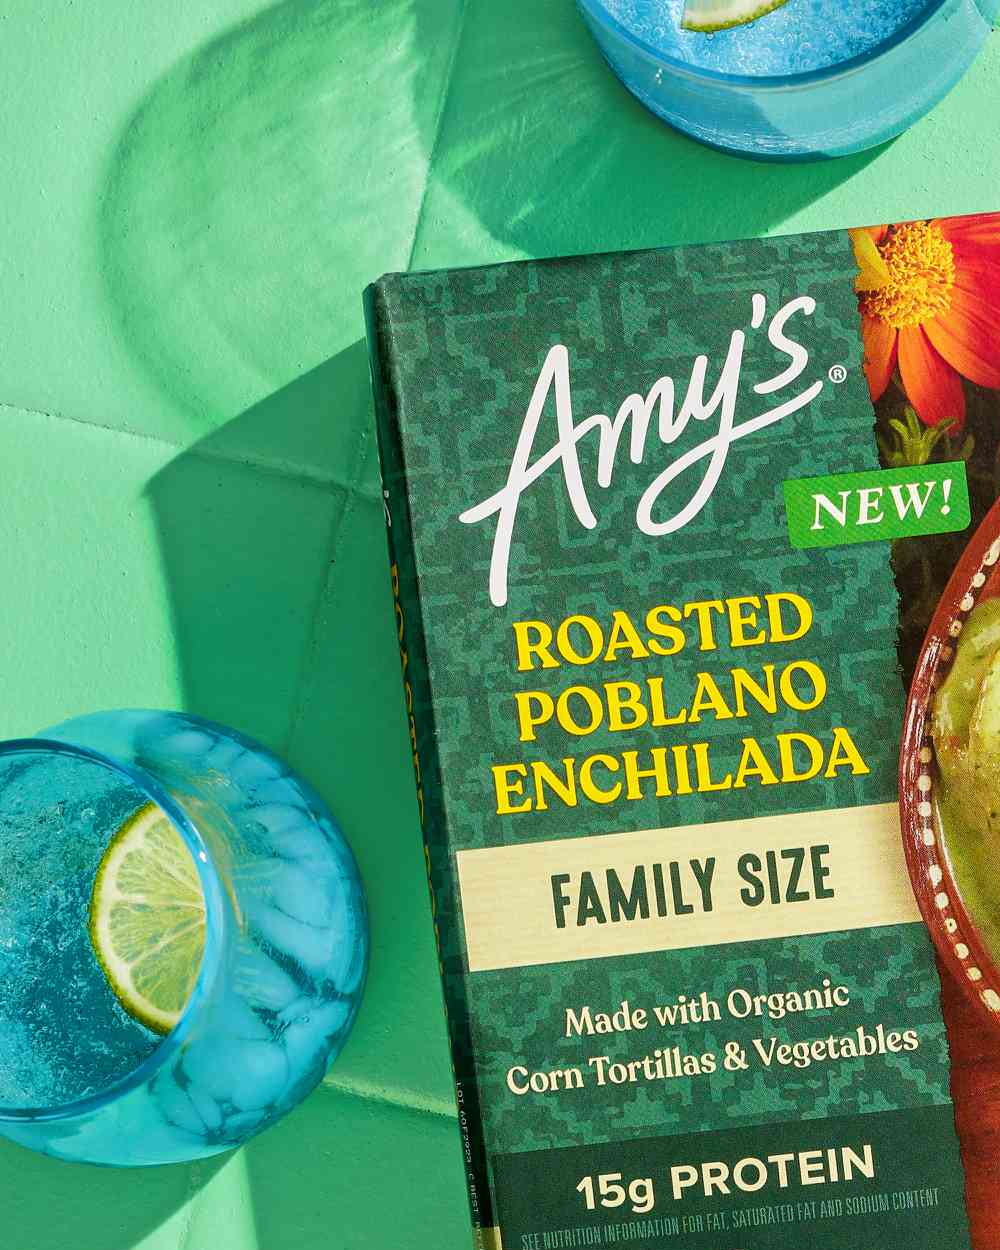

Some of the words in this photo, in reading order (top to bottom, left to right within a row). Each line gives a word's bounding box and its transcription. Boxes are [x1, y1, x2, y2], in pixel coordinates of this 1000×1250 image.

[810, 478, 953, 531] NEW!
[512, 591, 814, 672] ROASTED
[514, 660, 828, 742] POBLANO
[491, 726, 870, 816] ENCHILADA
[550, 857, 717, 930] FAMILY
[737, 844, 835, 909] SIZE
[564, 1001, 648, 1038] Made
[652, 993, 722, 1028] with
[727, 978, 851, 1019] Organic
[506, 1064, 585, 1097] Corn
[588, 1046, 717, 1087] Tortillas
[723, 1042, 750, 1072] &
[752, 1023, 920, 1069] Vegetables
[576, 1171, 656, 1214] 15g
[669, 1143, 876, 1201] PROTEIN
[542, 1223, 600, 1249] NUTRITION
[604, 1215, 680, 1243] INFORMATION
[682, 1213, 705, 1234] FOR
[731, 1203, 795, 1229] SATURATED
[797, 1200, 817, 1222] FAT
[819, 1198, 844, 1219] AND
[845, 1192, 891, 1216] SODIUM
[891, 1187, 940, 1211] CONTENT
